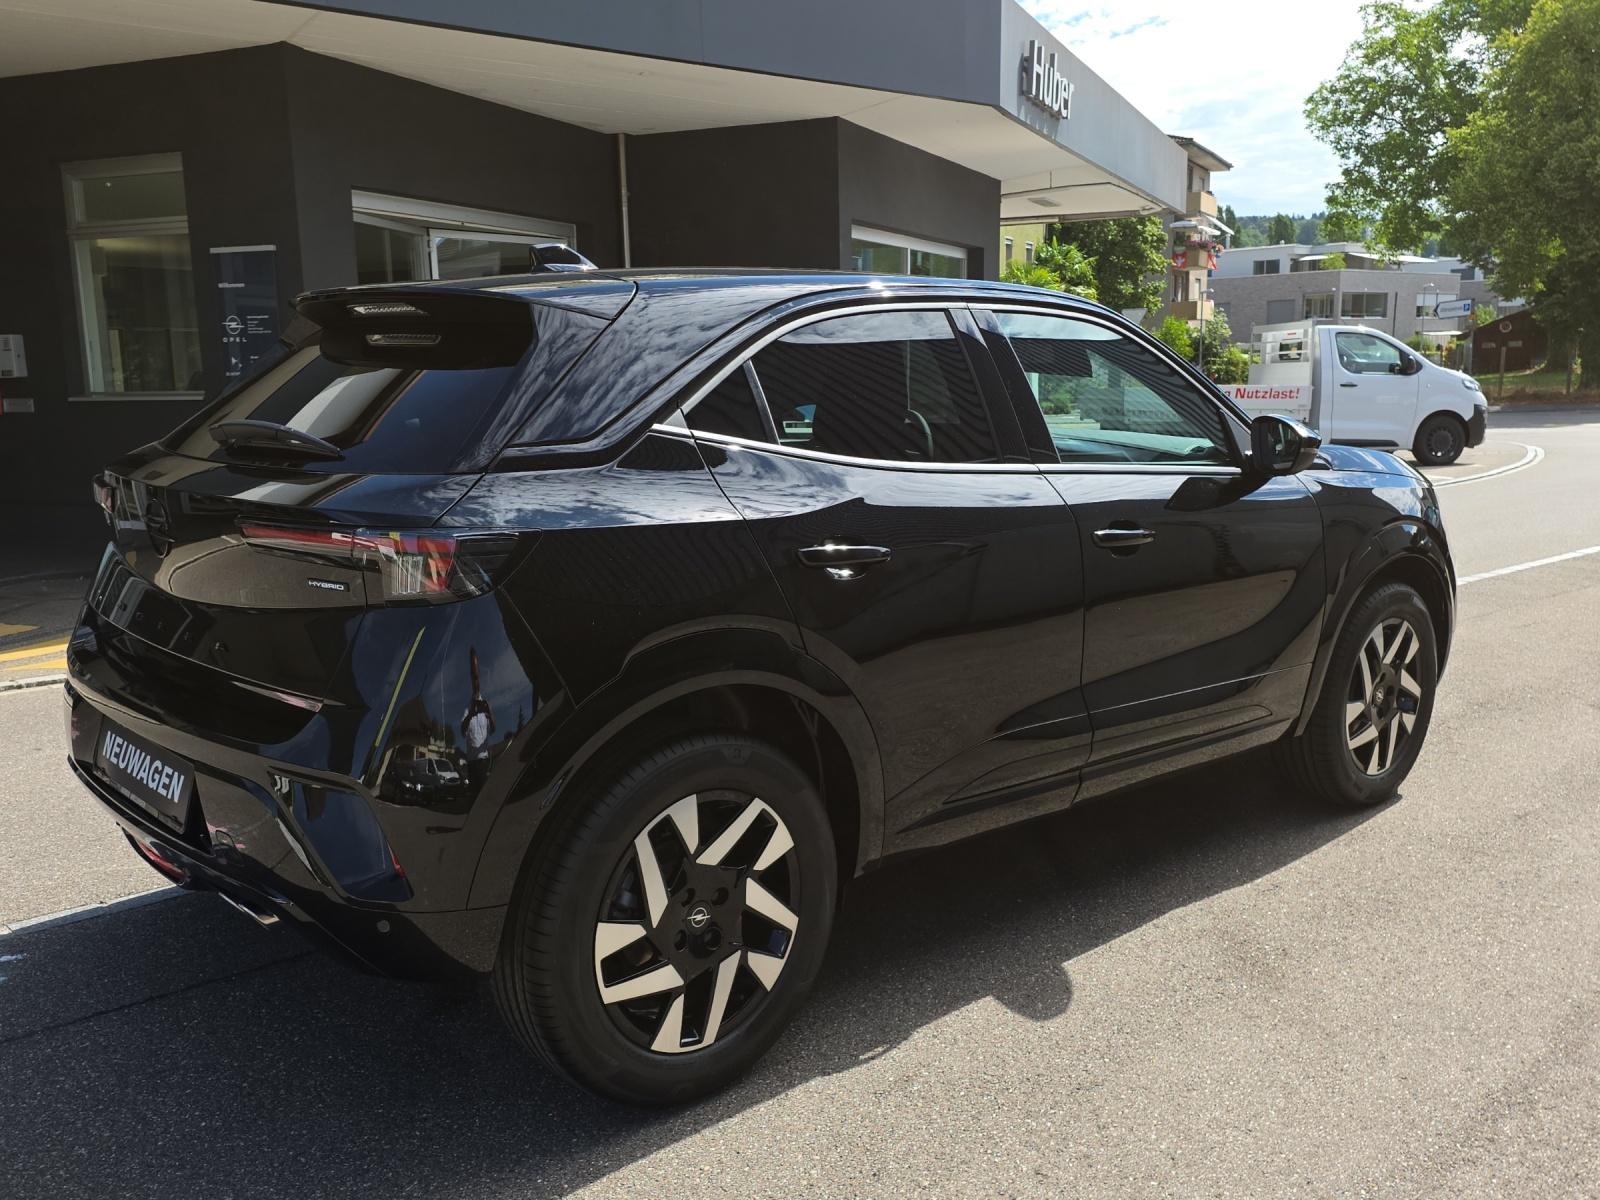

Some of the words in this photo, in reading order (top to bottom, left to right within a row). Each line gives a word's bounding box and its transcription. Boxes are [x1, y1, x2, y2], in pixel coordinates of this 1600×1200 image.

[1031, 39, 1075, 120] Huber
[1235, 387, 1300, 399] Nutzlast!
[308, 579, 344, 590] HYBRID
[102, 730, 185, 804] NEUWAGEN
